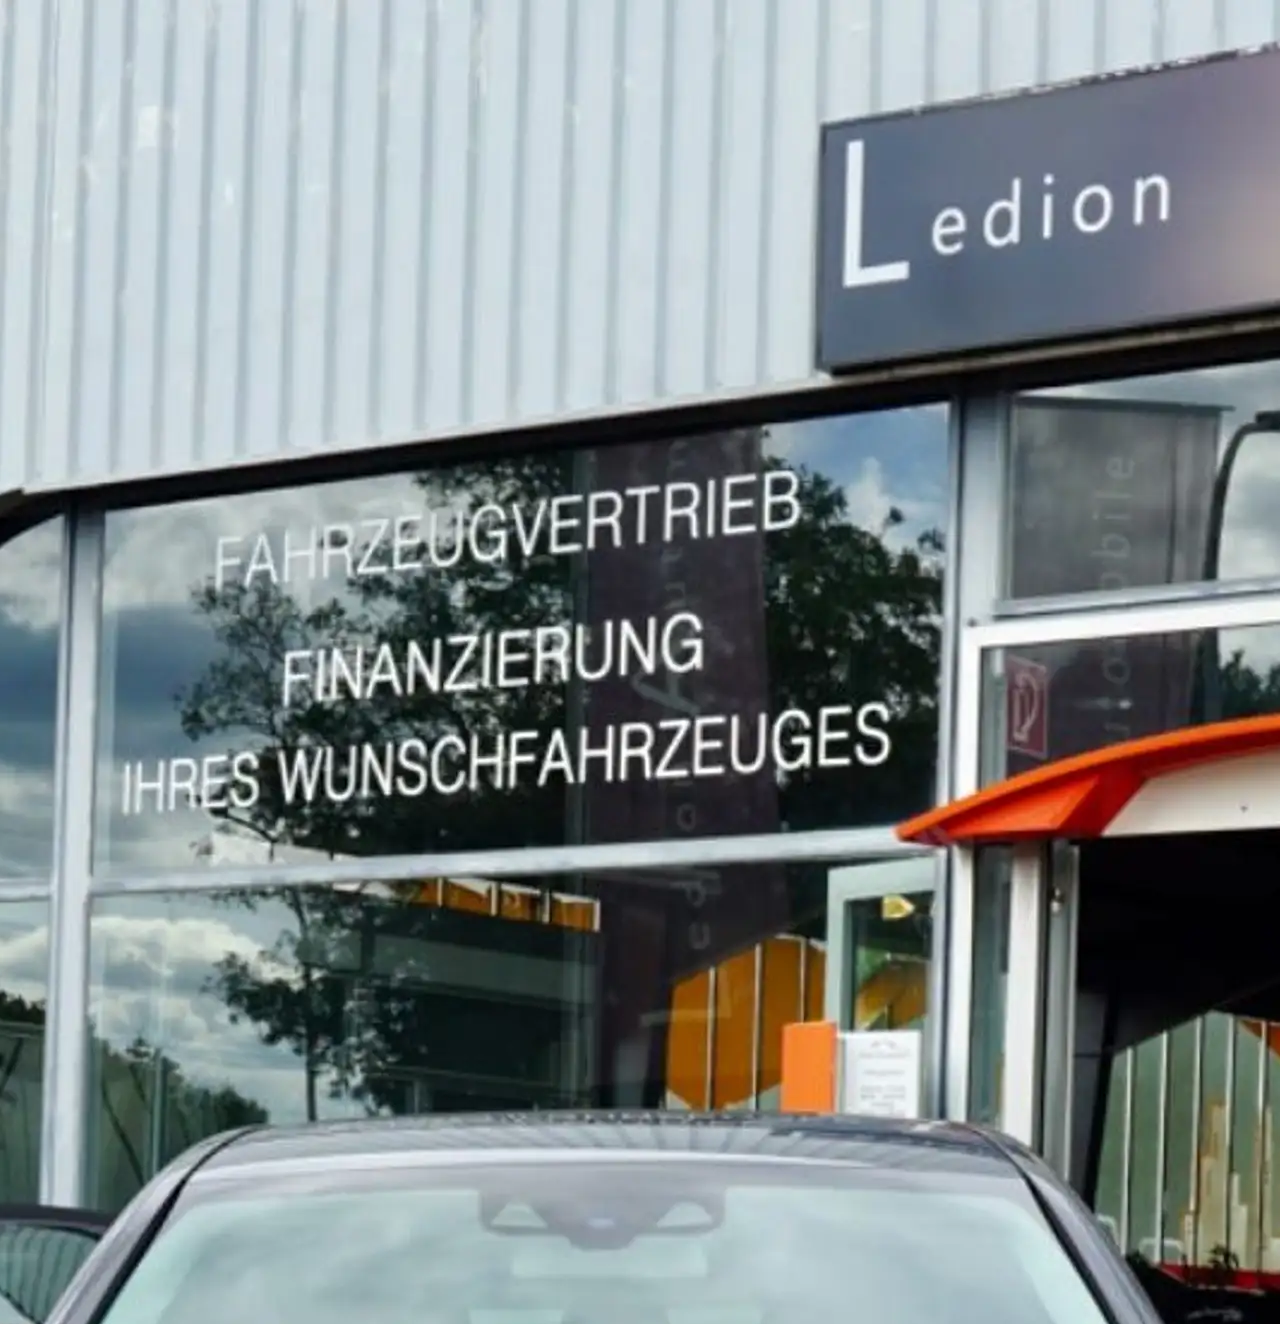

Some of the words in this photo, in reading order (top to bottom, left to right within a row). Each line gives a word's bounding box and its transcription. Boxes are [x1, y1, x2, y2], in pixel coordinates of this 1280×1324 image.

[841, 138, 1172, 289] Ledion
[215, 469, 802, 588] FAHRZEUGVERTRIEB
[282, 612, 705, 705] FINANZIERUNG
[123, 751, 259, 816] IHRES
[277, 703, 892, 803] WUNSCHFAHRZEUGES
